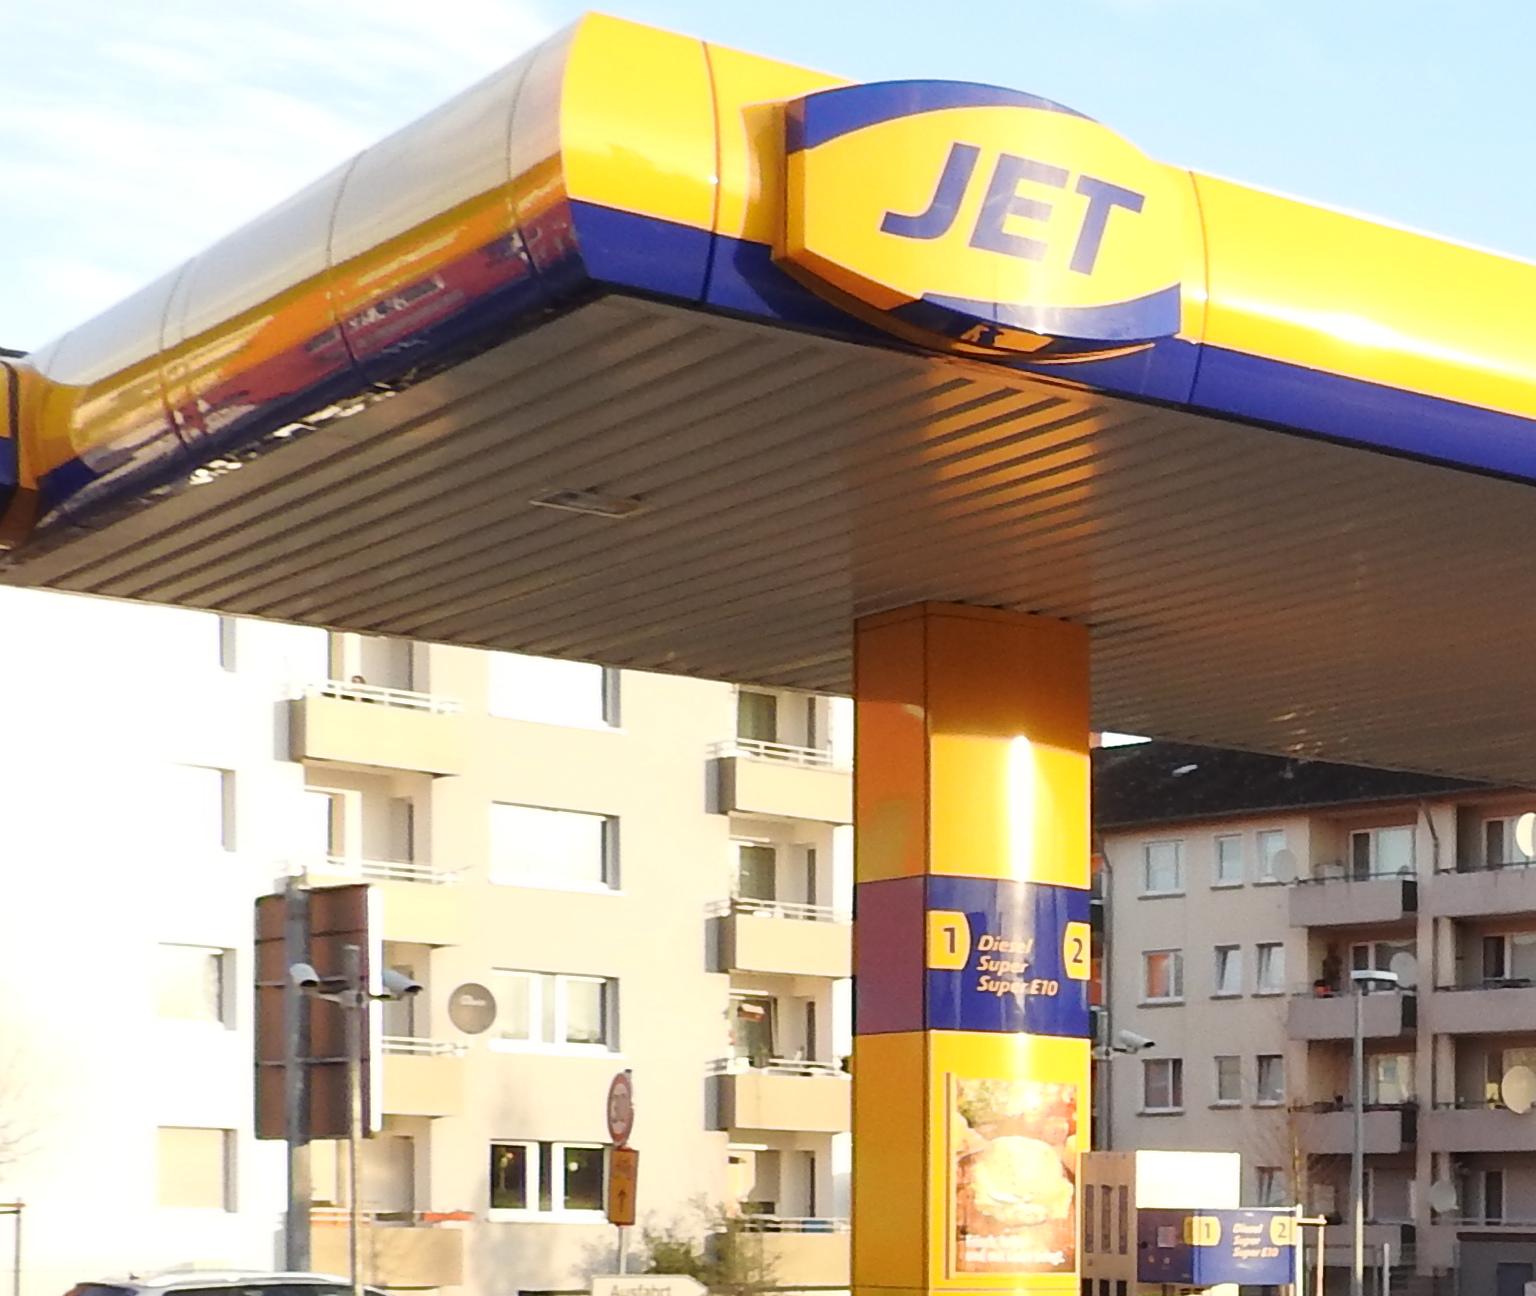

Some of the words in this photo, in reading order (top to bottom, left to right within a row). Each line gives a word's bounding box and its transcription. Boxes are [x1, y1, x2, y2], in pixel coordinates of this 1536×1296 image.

[880, 142, 1146, 276] JET
[943, 927, 956, 954] 1
[978, 935, 1034, 954] Diesel
[1072, 937, 1084, 964] 2
[976, 955, 1030, 977] Super
[976, 975, 1029, 997] Super
[1030, 978, 1059, 996] E10
[1203, 1222, 1211, 1239] 1
[1277, 1222, 1287, 1239] 2
